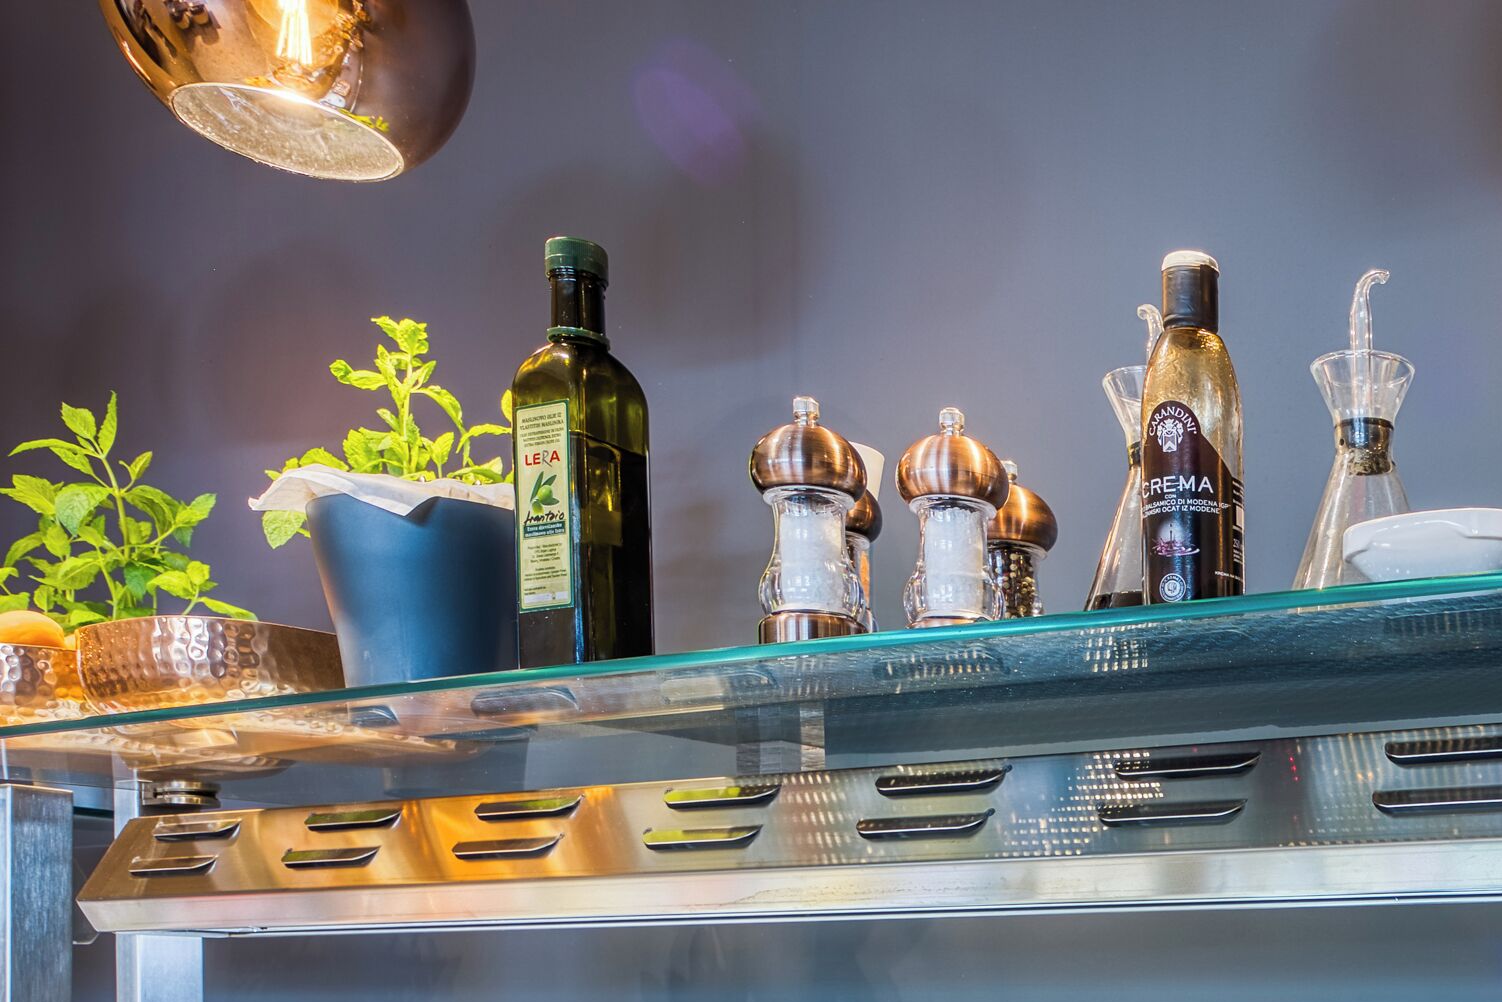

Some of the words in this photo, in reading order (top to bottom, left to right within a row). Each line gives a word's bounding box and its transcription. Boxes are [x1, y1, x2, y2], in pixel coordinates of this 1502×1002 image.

[1148, 406, 1197, 436] CARANDINI
[525, 450, 560, 468] LERA
[1142, 475, 1214, 499] CREMA
[1161, 505, 1180, 513] OCAT
[1189, 504, 1220, 514] MODENE
[1186, 498, 1218, 508] MODENA
